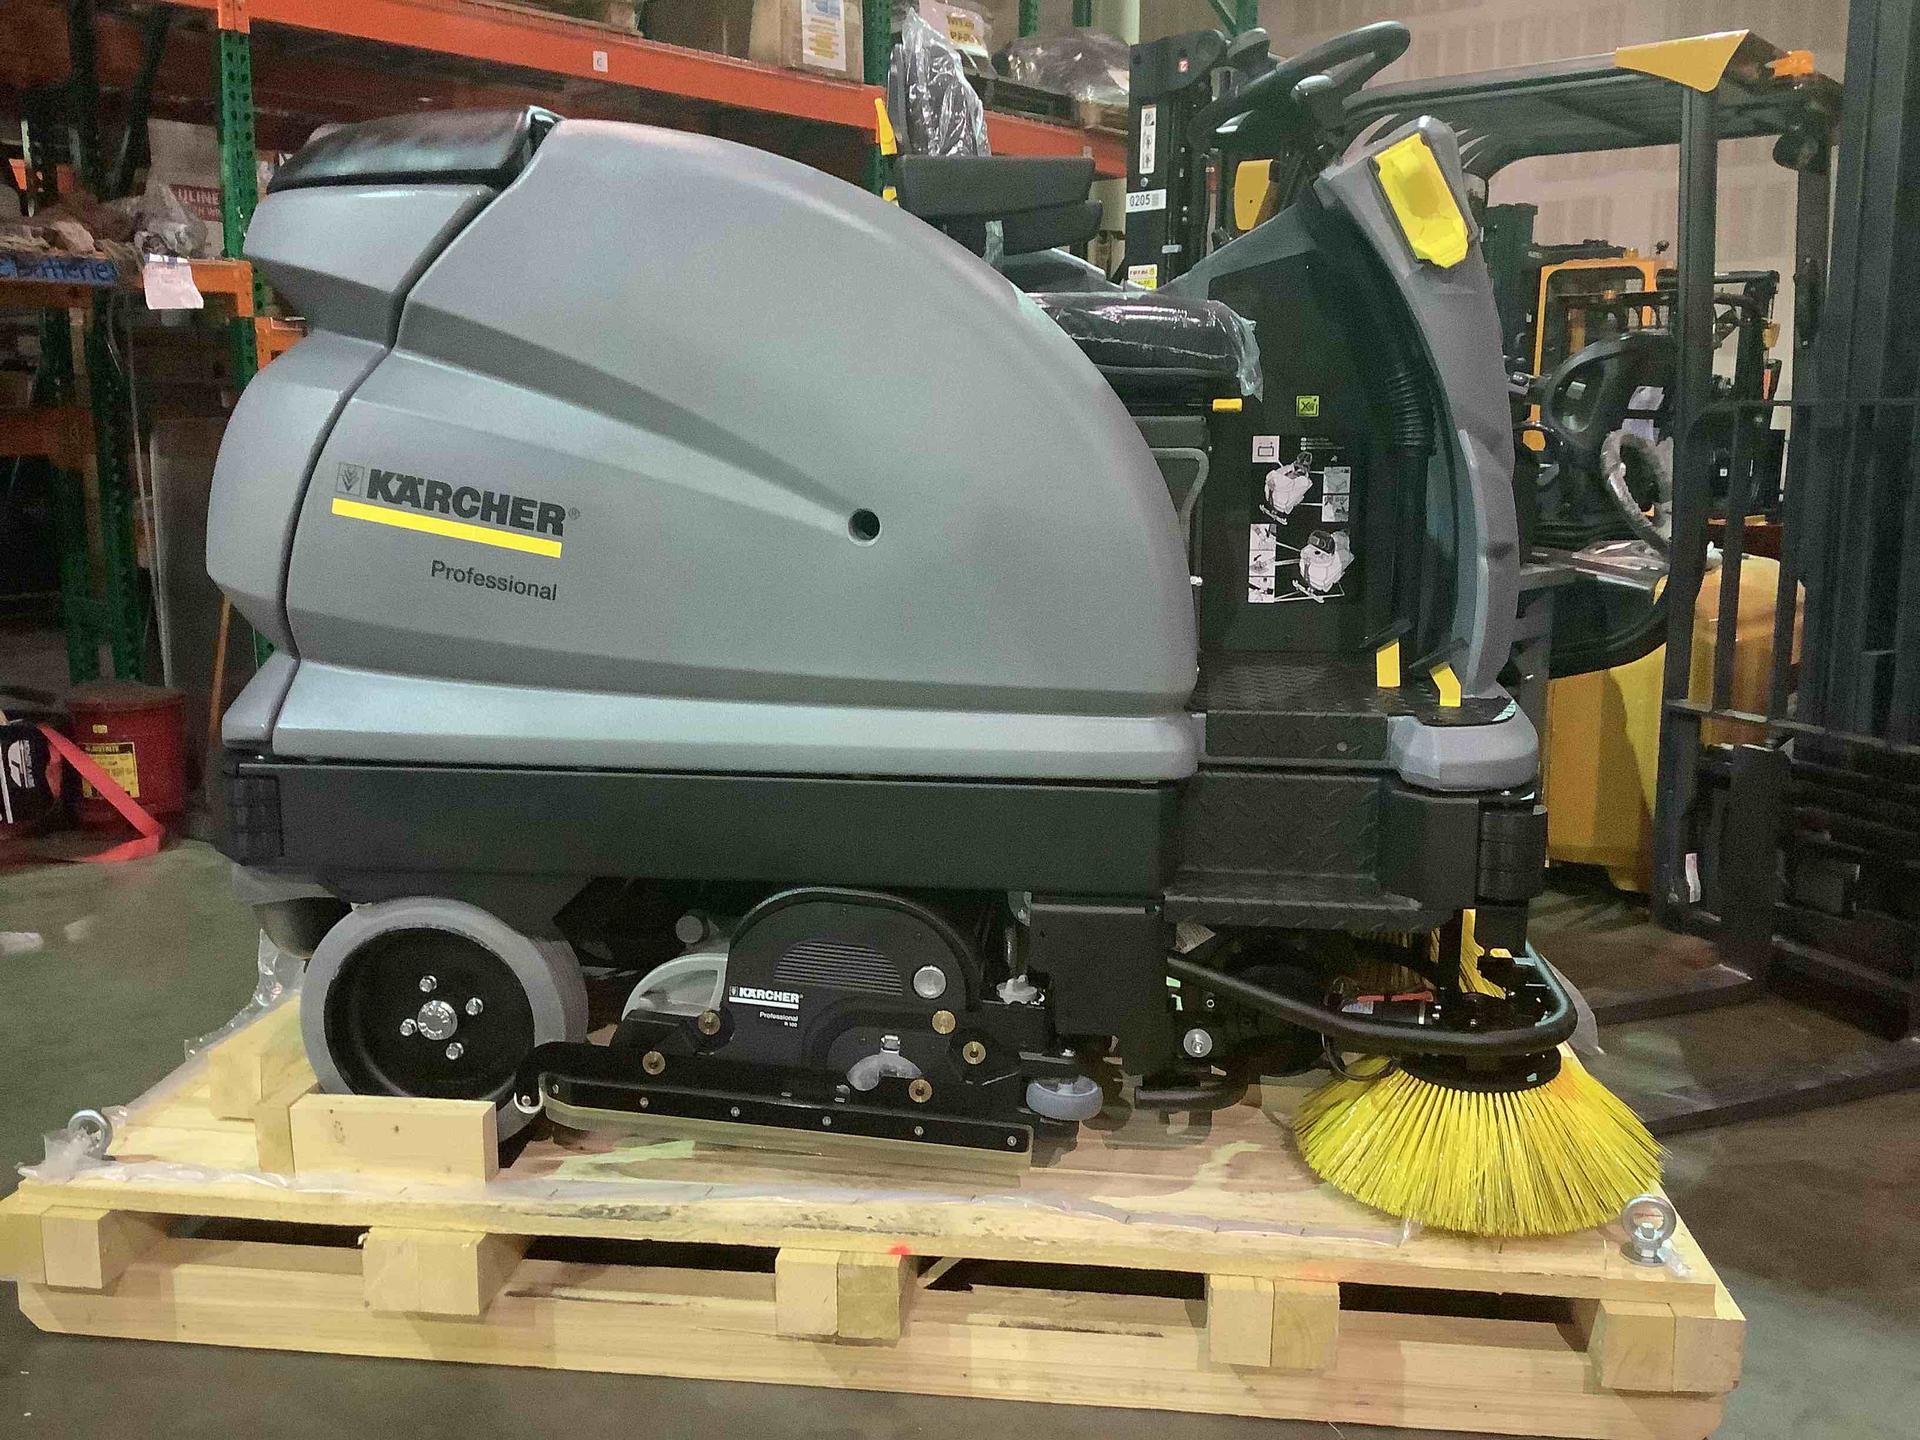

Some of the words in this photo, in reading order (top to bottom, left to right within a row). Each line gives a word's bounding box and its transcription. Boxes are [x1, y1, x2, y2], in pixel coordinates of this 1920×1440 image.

[1129, 193, 1151, 207] 0205
[366, 468, 567, 537] KÄRCHER
[431, 559, 558, 601] Professional
[738, 987, 800, 1004] KÄRCHER
[759, 1011, 799, 1022] Professional
